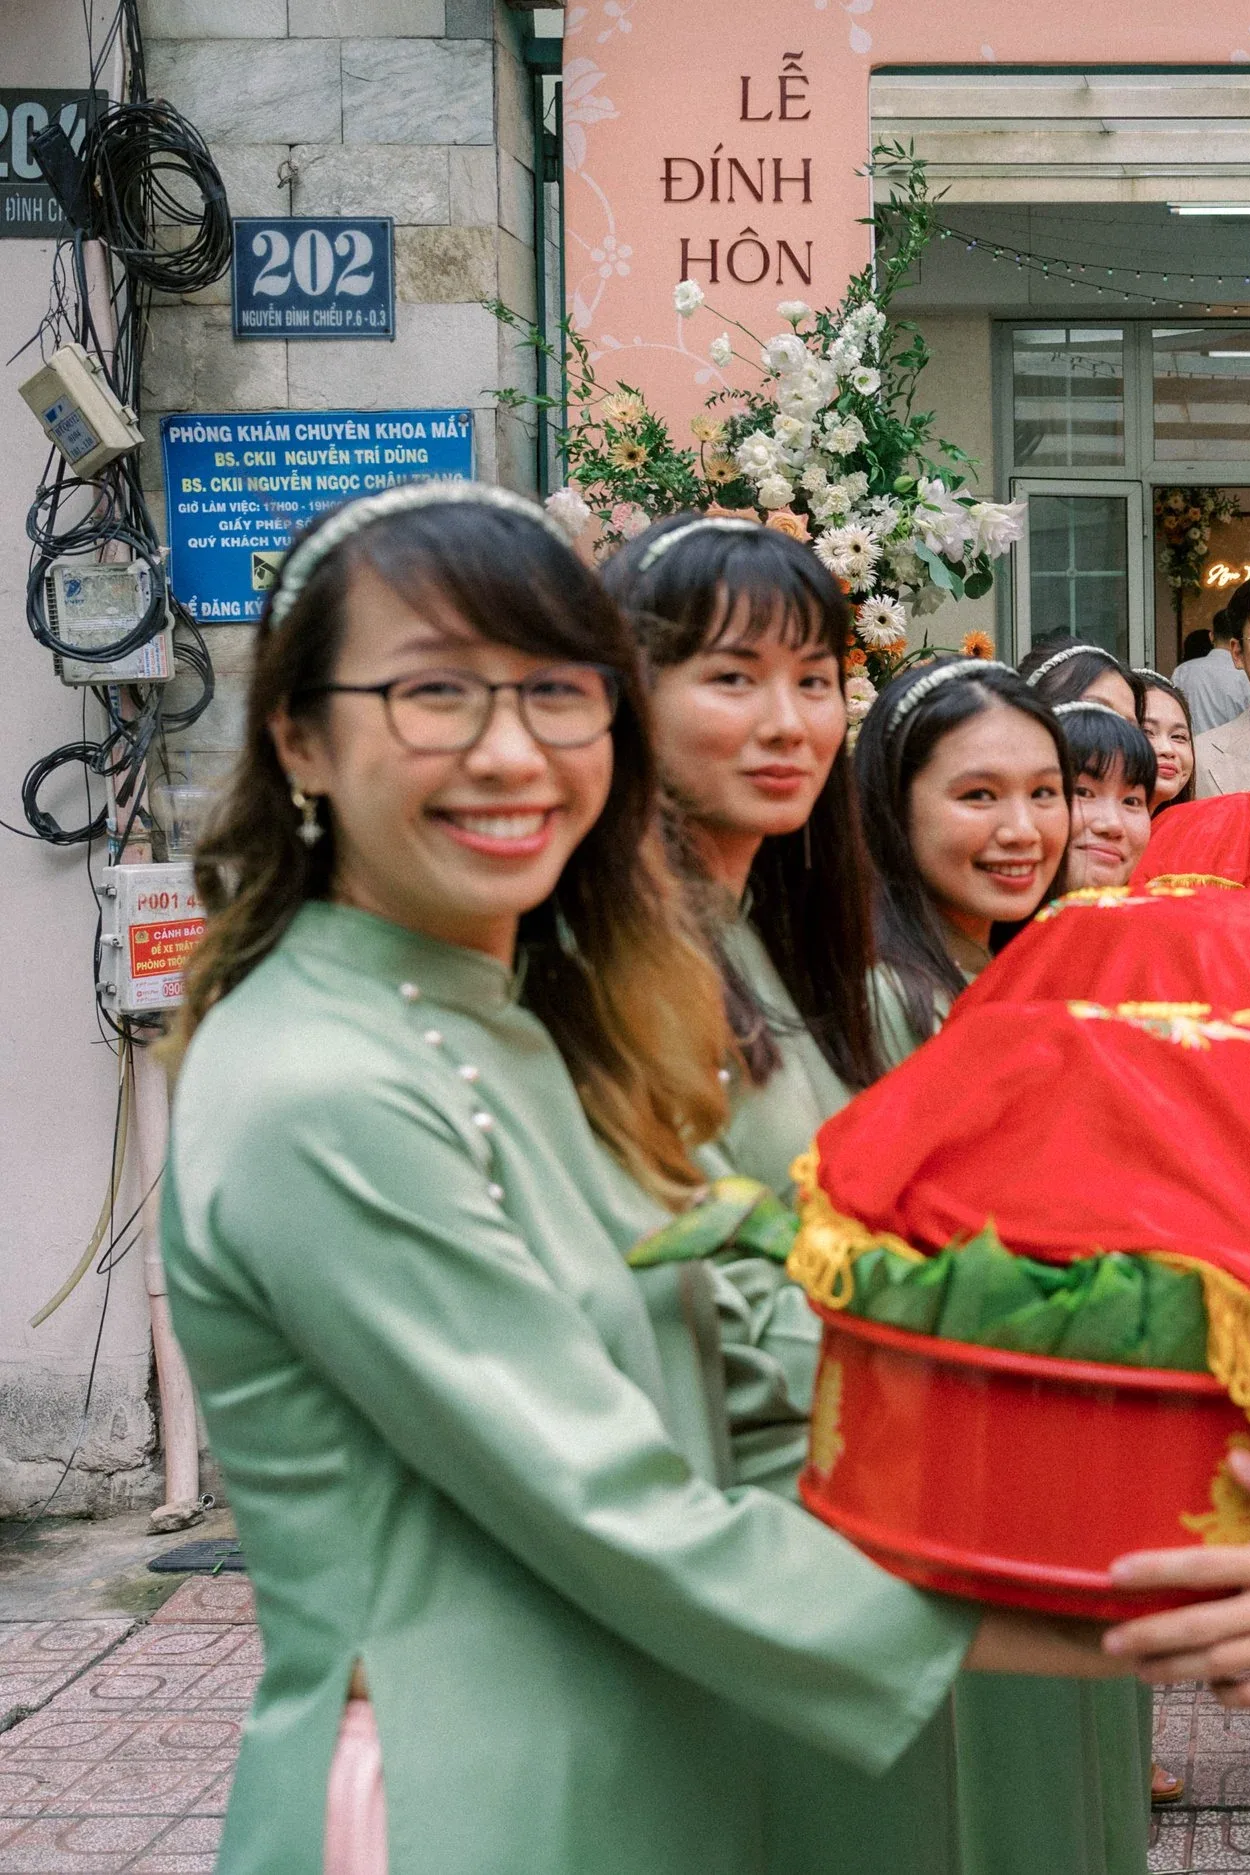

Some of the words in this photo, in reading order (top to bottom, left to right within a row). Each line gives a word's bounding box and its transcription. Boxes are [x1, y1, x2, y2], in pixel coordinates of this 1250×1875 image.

[740, 51, 811, 121] LỄ
[660, 142, 813, 203] ĐÍNH
[5, 192, 43, 222] ĐÌNH
[252, 229, 375, 296] 202
[680, 226, 813, 285] HÔN
[242, 303, 282, 327] NGUYỄN
[285, 306, 310, 327] ĐÌNH
[313, 302, 342, 327] CHIỂU
[169, 422, 233, 443] PHÒNG
[237, 421, 290, 442] KHÁM
[295, 420, 370, 441] CHUYÊN
[375, 422, 426, 440] KHOA
[431, 415, 469, 438] MẮT
[214, 452, 240, 467] BS.
[244, 451, 276, 467] CKII
[285, 444, 350, 466] NGUYỄN
[354, 445, 380, 464] TRÍ
[384, 445, 428, 464] DŨNG
[181, 478, 206, 493] BS.
[211, 477, 243, 493] CKII
[247, 469, 312, 492] NGUYỄN
[316, 475, 360, 494] NGỌC
[178, 500, 199, 513] GIỜ
[202, 500, 226, 513] LÀM
[229, 500, 260, 516] VIỆC:
[264, 501, 298, 512] 17H00
[219, 517, 250, 531] GIẤY
[256, 517, 292, 530] PHÉP
[188, 535, 216, 548] QUÝ
[221, 535, 269, 547] KHÁCH
[202, 598, 240, 617] ĐĂNG
[153, 928, 181, 940] CẢNH
[184, 924, 204, 936] BÁO
[163, 944, 174, 953] XE
[136, 959, 166, 971] PHÒNG
